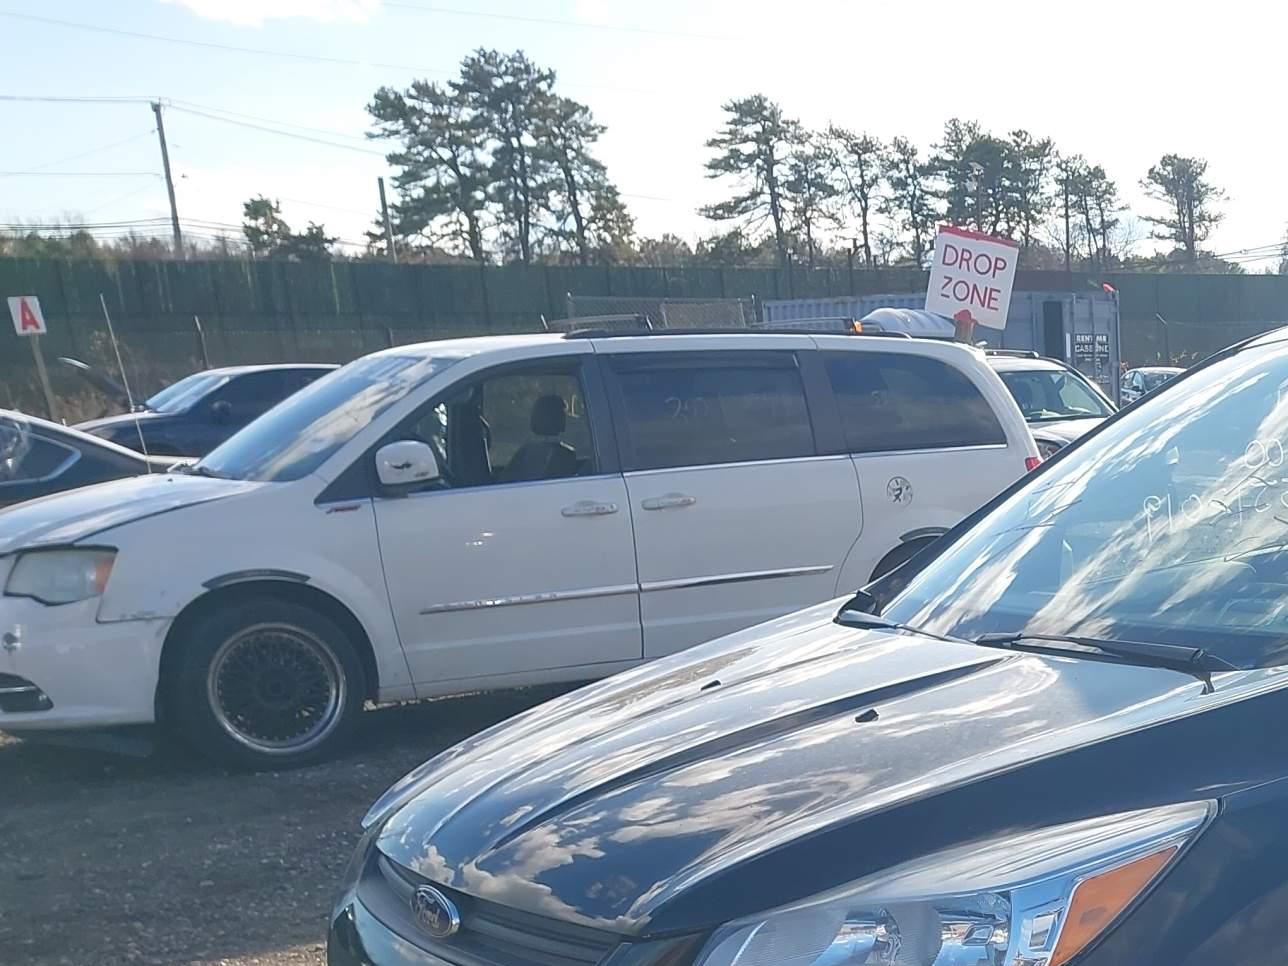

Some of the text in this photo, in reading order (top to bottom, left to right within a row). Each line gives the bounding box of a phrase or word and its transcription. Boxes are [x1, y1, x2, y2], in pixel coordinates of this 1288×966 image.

[942, 244, 1007, 279] DROP
[940, 275, 1001, 311] ZONE
[21, 298, 40, 330] A
